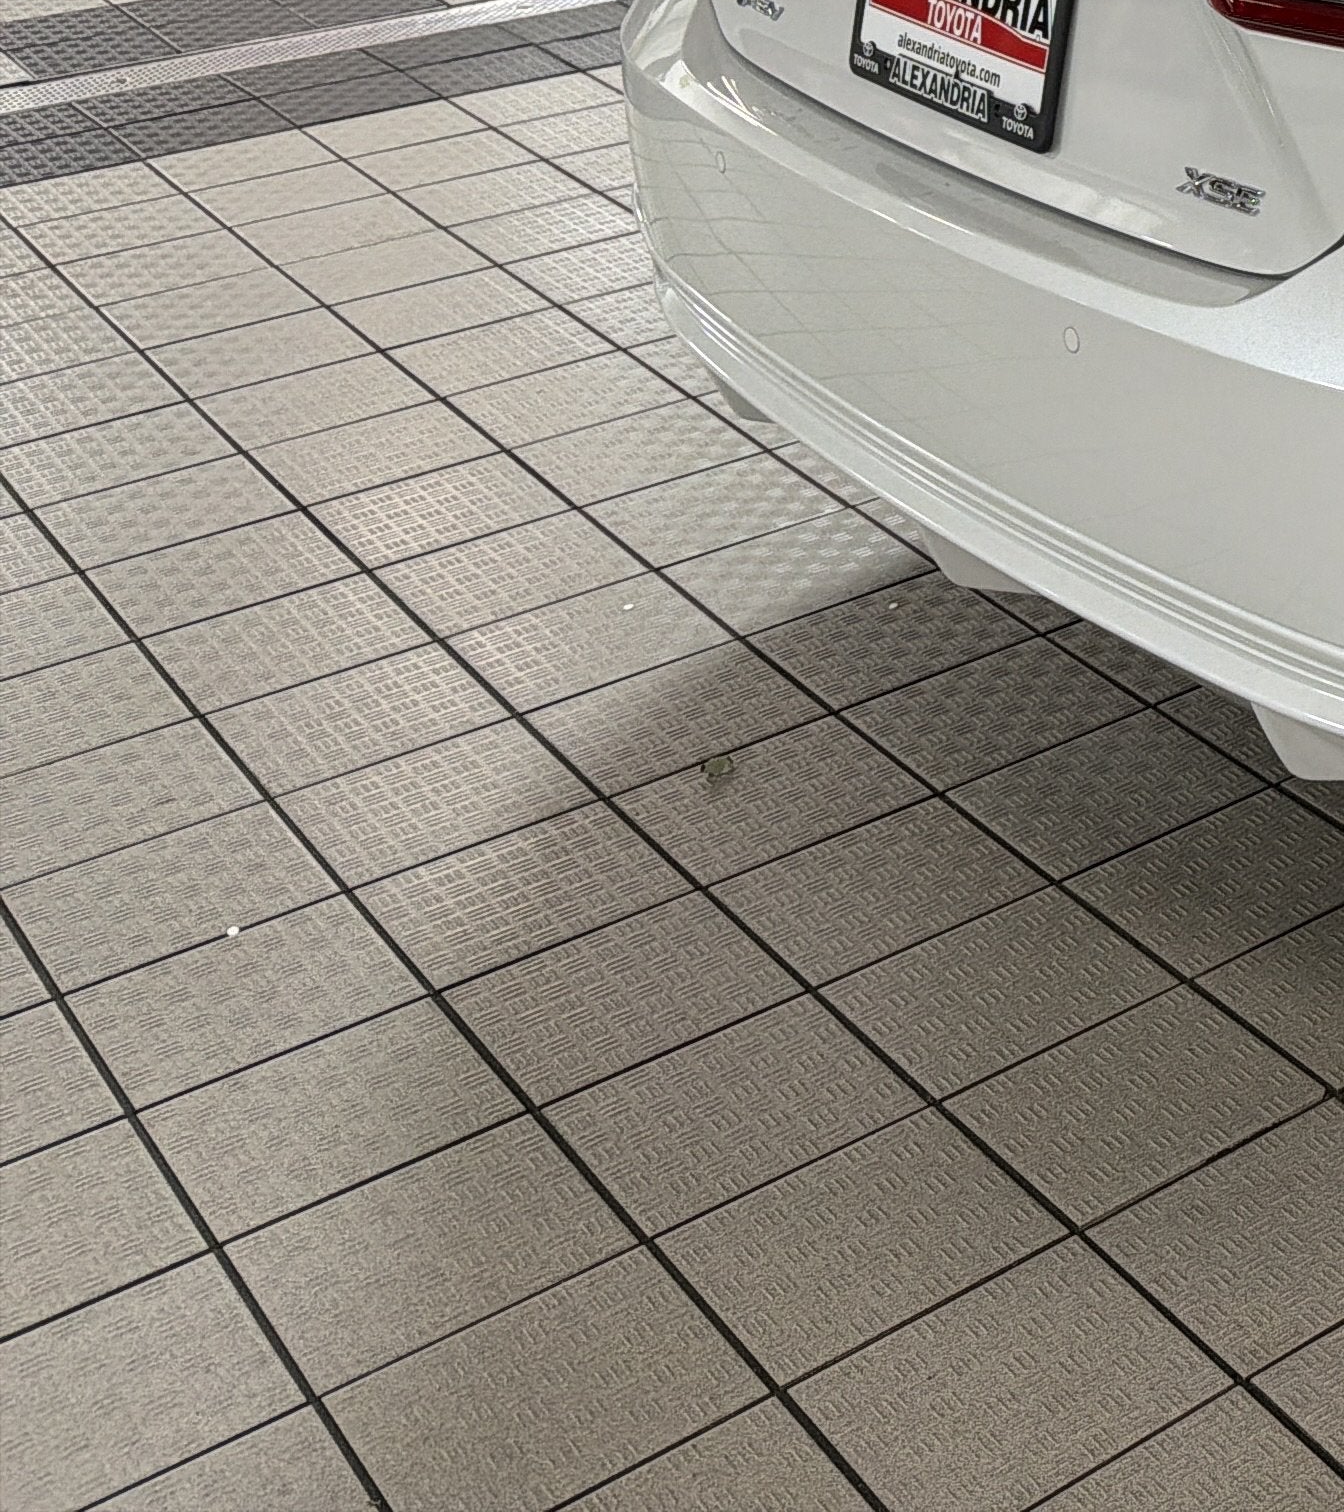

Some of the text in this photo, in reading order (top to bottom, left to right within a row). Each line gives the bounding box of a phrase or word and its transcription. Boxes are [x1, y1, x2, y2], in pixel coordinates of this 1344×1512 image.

[853, 53, 879, 75] TOYOTA
[897, 31, 1001, 89] alexandriatoyota.com
[889, 56, 990, 123] ALEXANDRIA
[1001, 116, 1035, 140] TOYOTA
[1176, 167, 1266, 217] XSE
